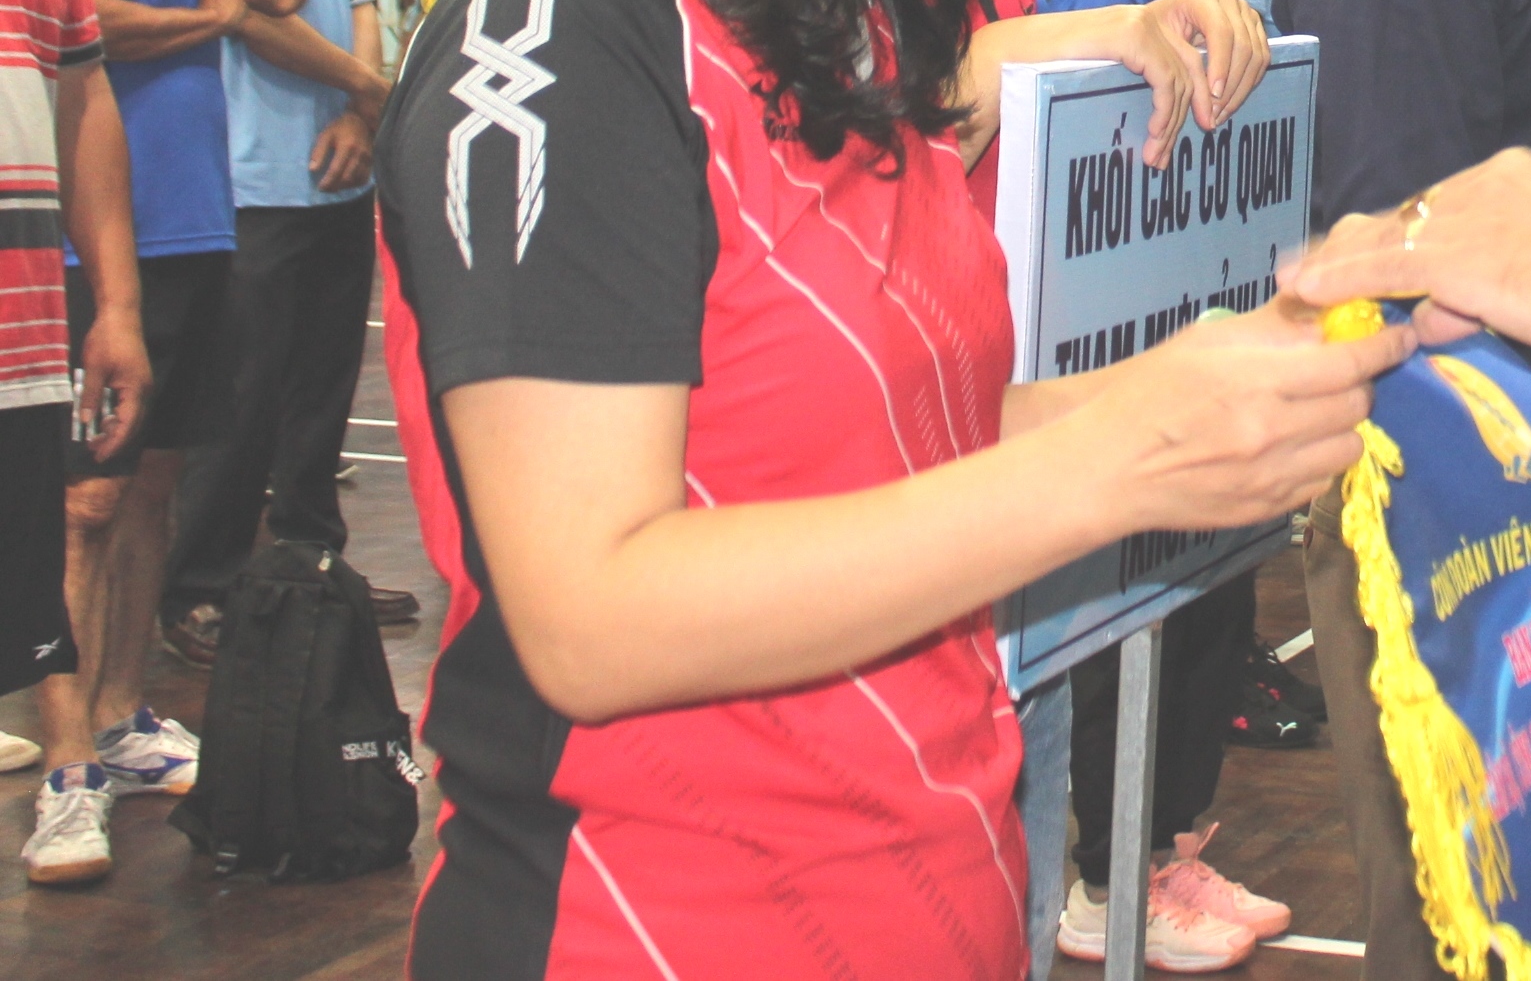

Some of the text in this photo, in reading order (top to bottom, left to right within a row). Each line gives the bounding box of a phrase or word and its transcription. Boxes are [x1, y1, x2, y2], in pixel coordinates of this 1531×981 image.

[1064, 112, 1134, 260] KHỐI
[1198, 118, 1233, 226] CƠ
[1236, 115, 1296, 225] QUAN
